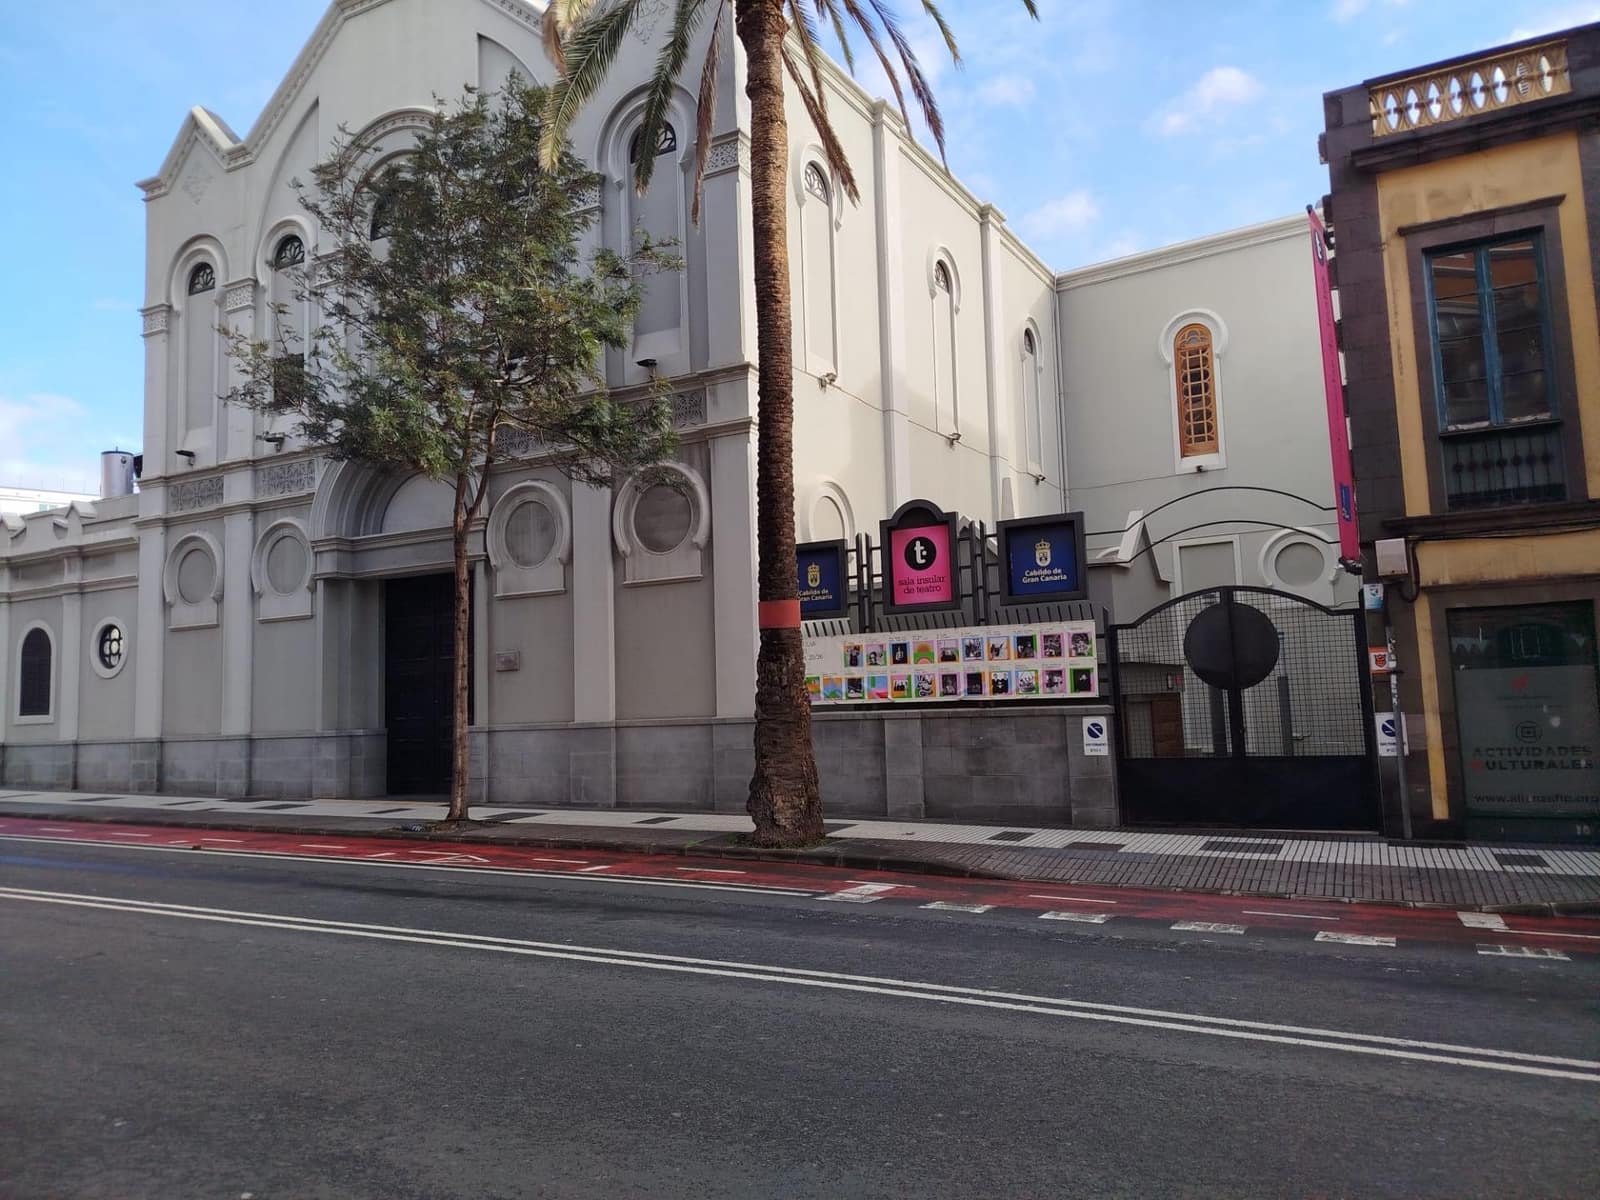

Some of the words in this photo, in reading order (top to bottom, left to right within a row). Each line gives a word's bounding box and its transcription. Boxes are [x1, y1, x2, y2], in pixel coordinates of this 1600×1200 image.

[1024, 568, 1052, 577] Cabildo
[898, 577, 915, 586] sala
[916, 575, 945, 585] insular
[1040, 574, 1067, 582] Canaria
[903, 585, 915, 594] de
[916, 585, 941, 593] teatro
[1473, 745, 1593, 757] ACTIVIDADES
[1471, 759, 1594, 770] ULTURALES
